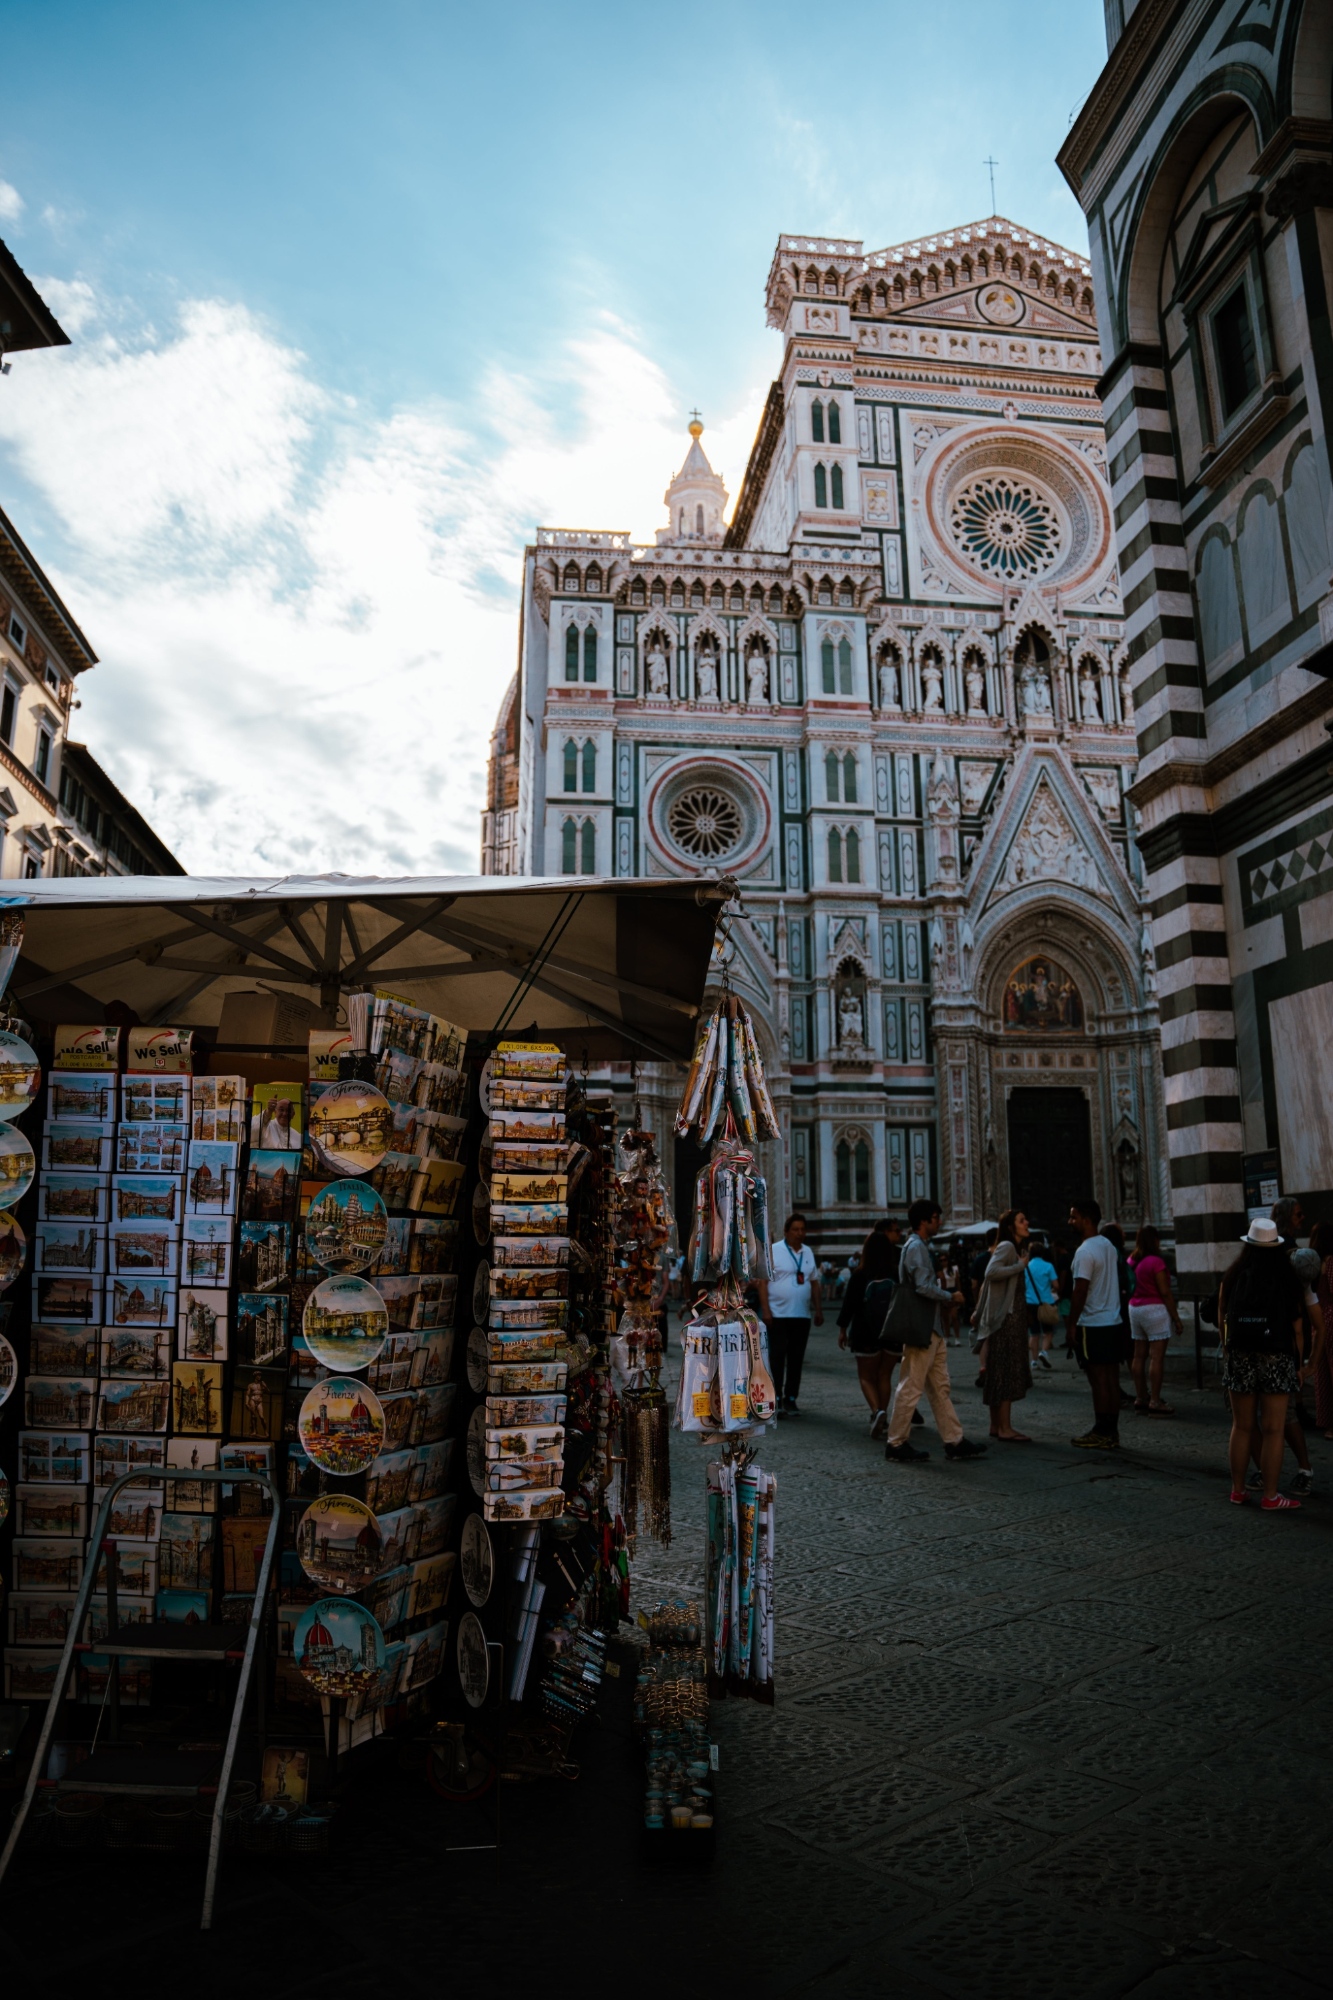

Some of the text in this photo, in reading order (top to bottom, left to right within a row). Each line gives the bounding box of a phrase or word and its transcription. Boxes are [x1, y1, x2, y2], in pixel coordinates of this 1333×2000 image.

[85, 1040, 109, 1054] Sell
[135, 1043, 182, 1060] We Sell
[315, 1054, 338, 1065] We
[329, 1080, 377, 1101] Firenze
[321, 1385, 355, 1400] Firenze
[317, 1496, 367, 1516] Firenze
[316, 1600, 365, 1615] Firenze
